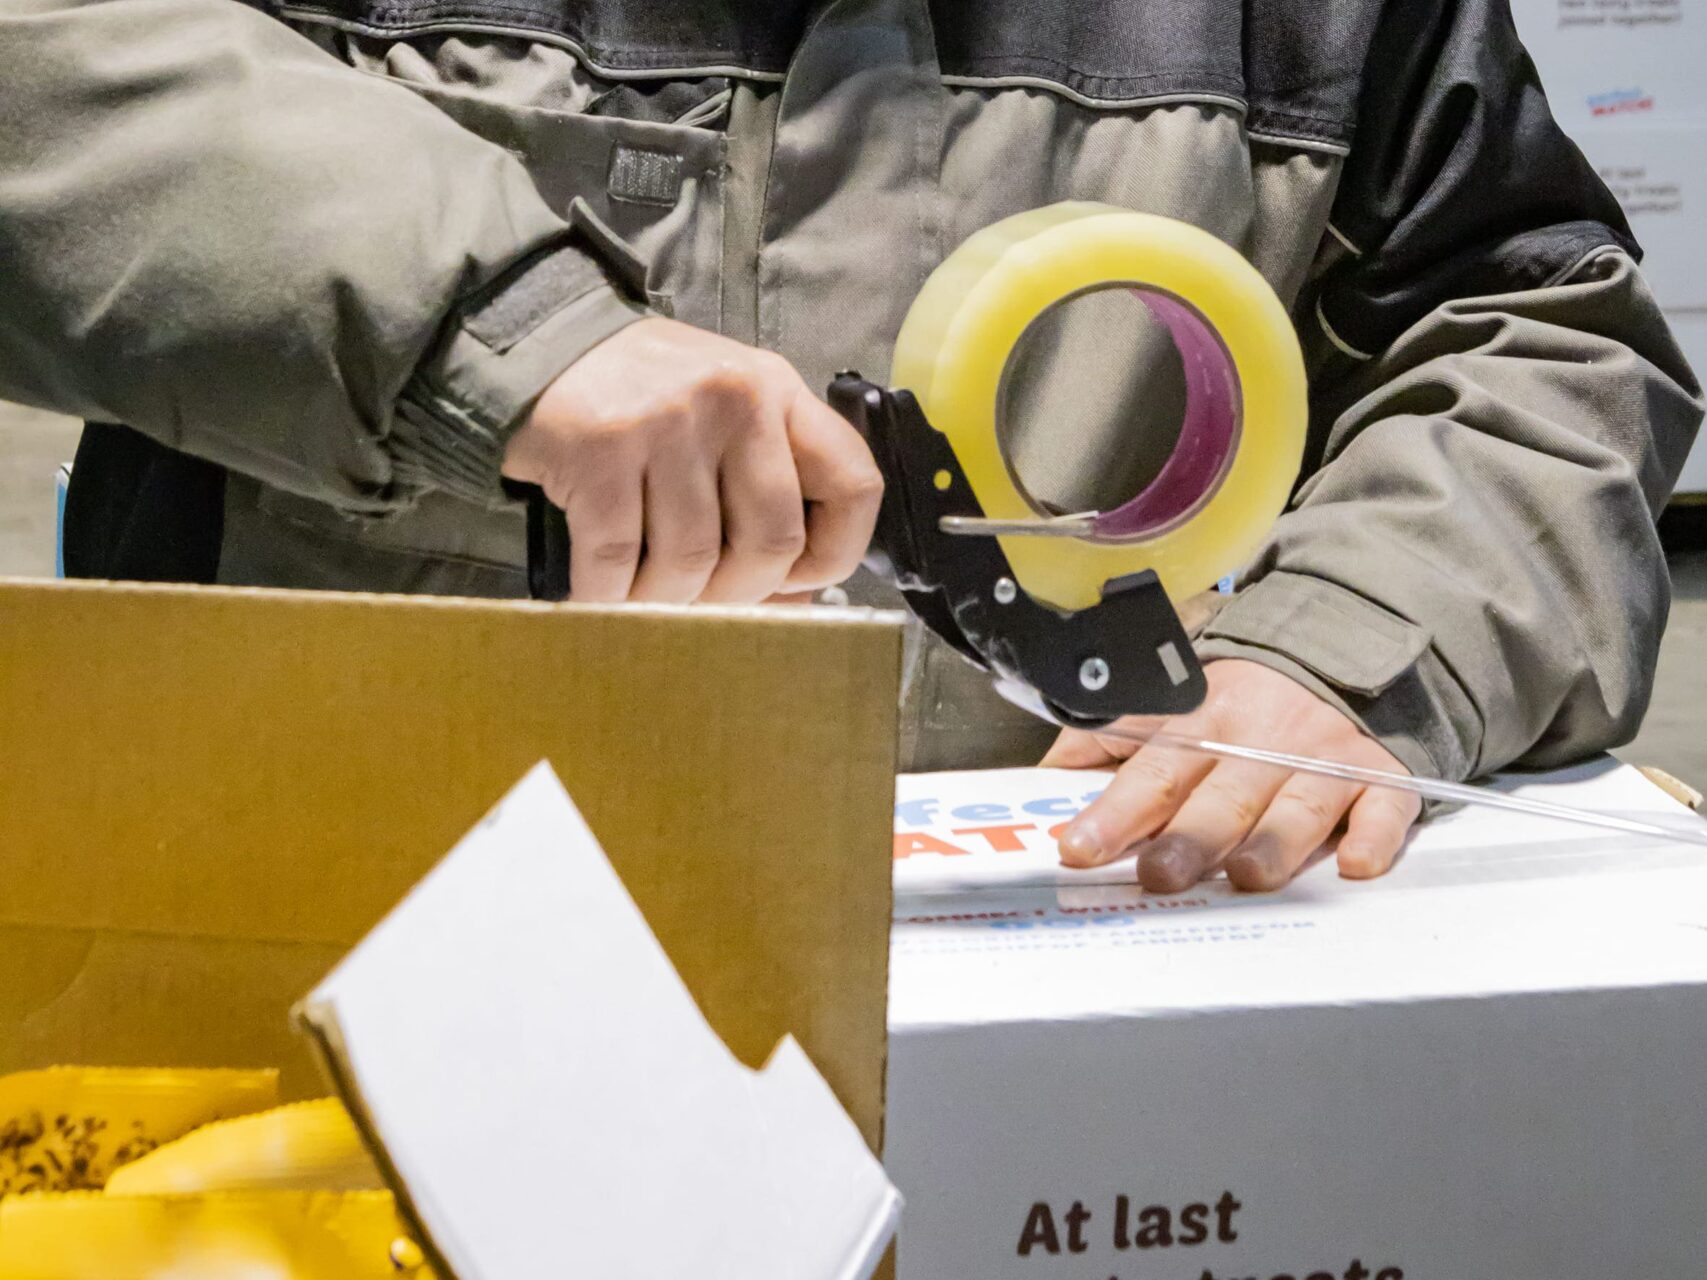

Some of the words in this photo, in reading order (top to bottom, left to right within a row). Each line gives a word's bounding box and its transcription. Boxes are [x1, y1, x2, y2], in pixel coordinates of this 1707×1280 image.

[893, 820, 1068, 860] AT
[1016, 1201, 1093, 1256] At
[1112, 1191, 1242, 1250] last
